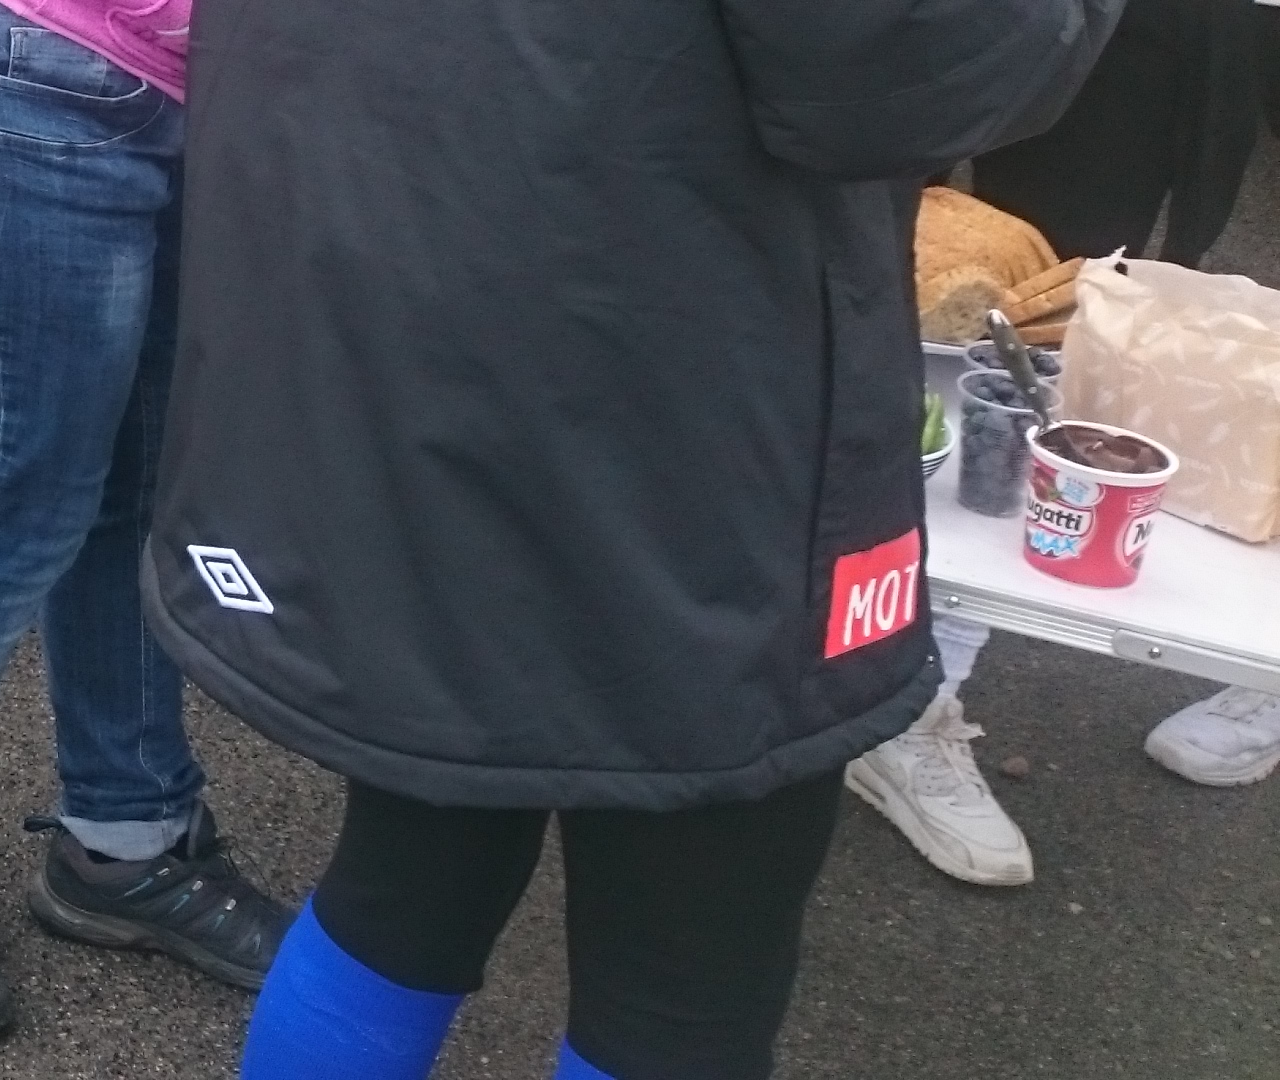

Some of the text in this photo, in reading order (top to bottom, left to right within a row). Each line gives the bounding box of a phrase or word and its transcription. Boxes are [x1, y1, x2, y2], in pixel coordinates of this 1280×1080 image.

[1027, 497, 1083, 532] ugatti
[1031, 531, 1080, 557] MAX
[843, 561, 919, 646] MOT
